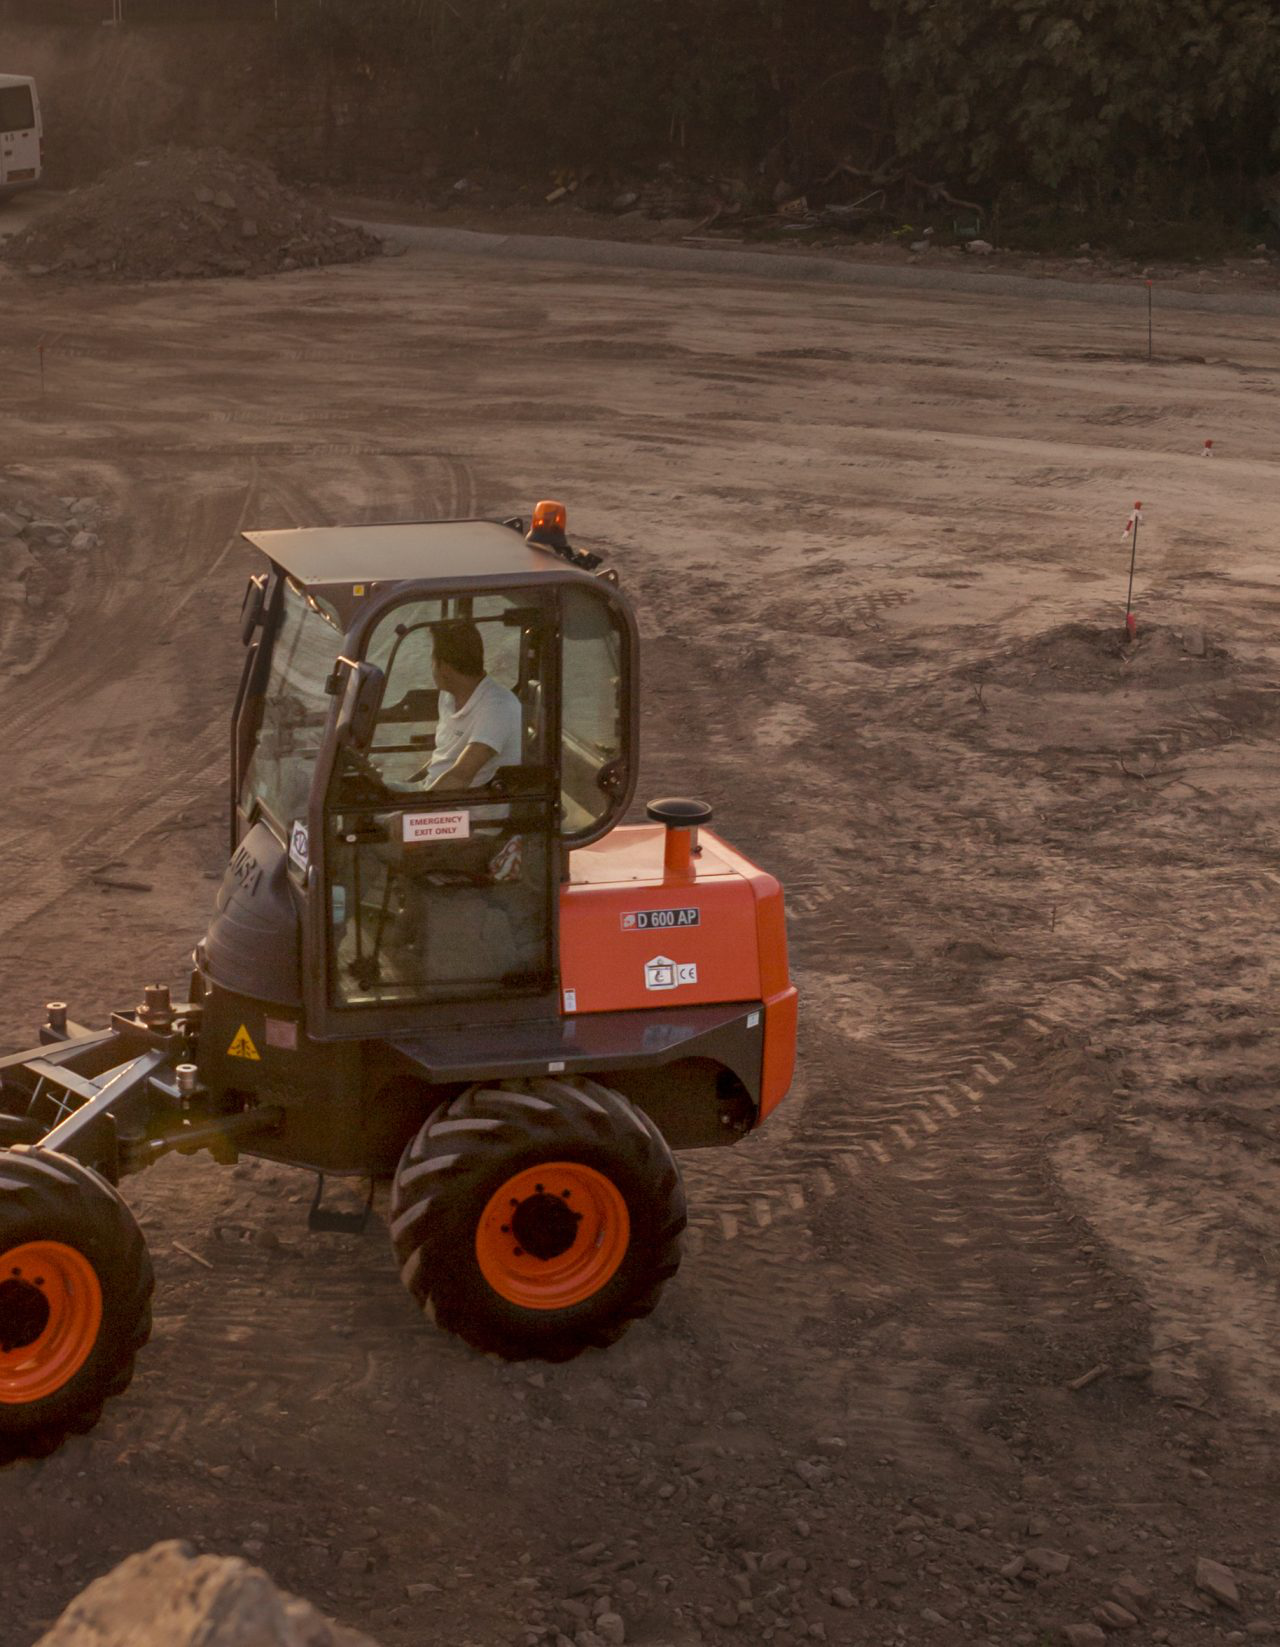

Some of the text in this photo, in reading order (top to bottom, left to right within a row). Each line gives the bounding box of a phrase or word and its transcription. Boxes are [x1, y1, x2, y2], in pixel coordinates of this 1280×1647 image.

[410, 816, 462, 826] EMERGENCY
[435, 827, 456, 835] ONLY
[638, 910, 696, 928] D 600 AP
[680, 968, 695, 980] CE
